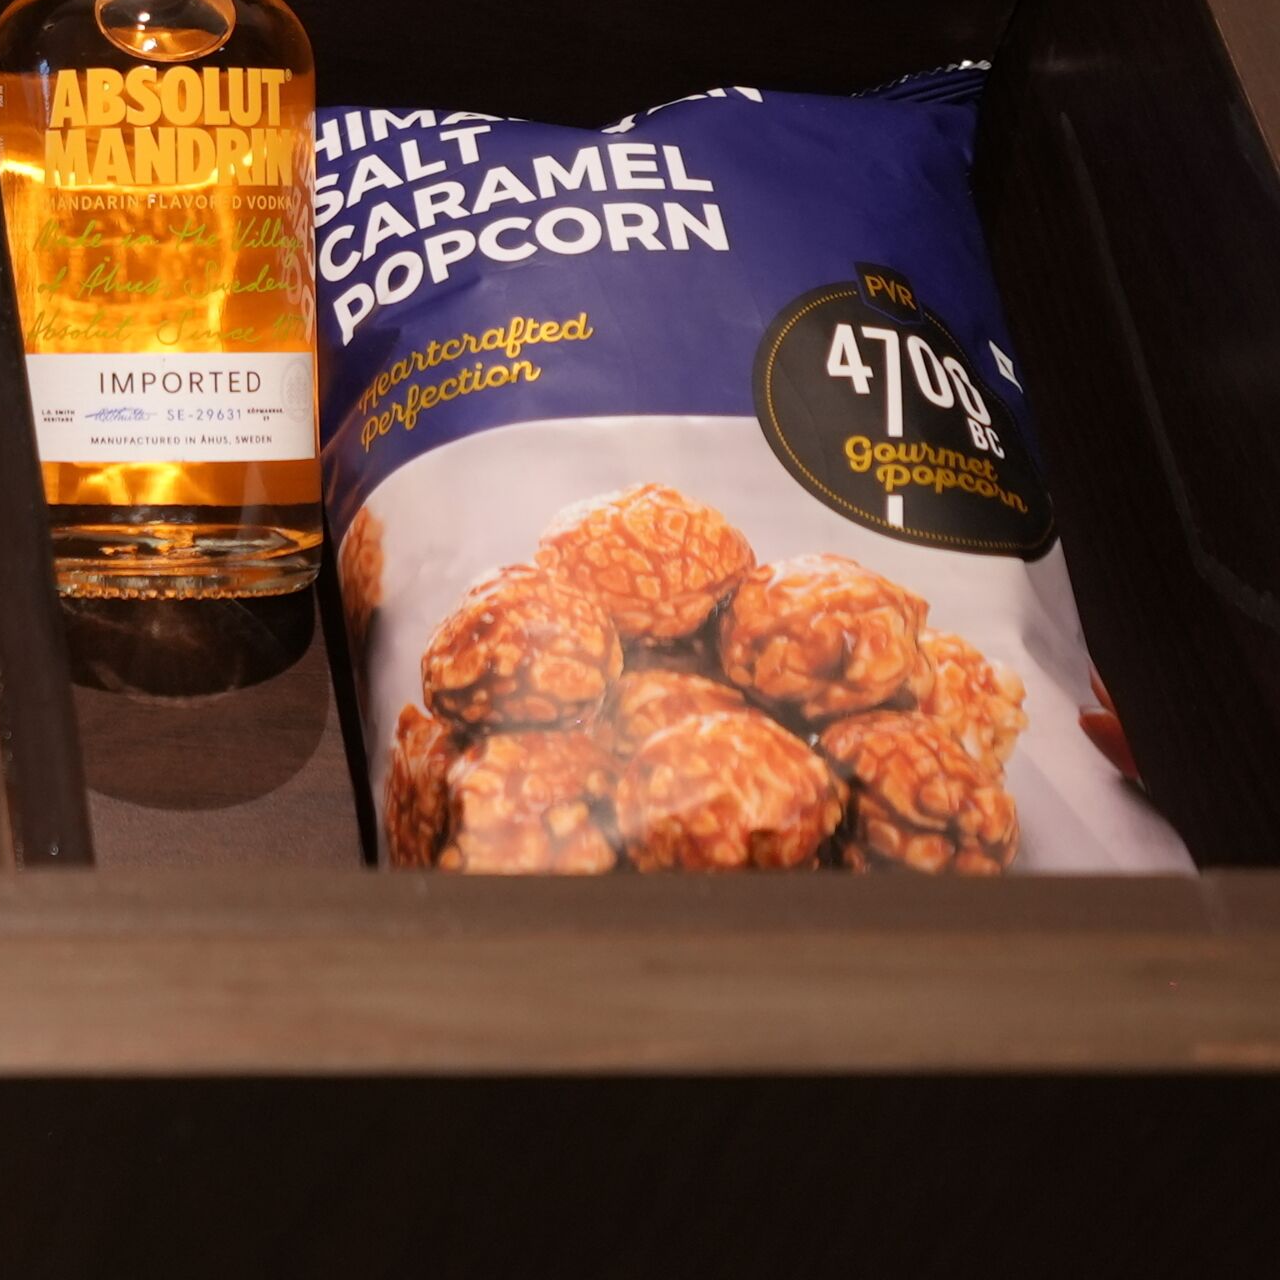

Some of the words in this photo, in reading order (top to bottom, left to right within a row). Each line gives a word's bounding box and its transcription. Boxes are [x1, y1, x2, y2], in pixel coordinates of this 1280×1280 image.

[48, 66, 288, 129] ABSOLUT
[44, 127, 292, 187] MANDRIN
[315, 125, 492, 228] SALT
[146, 194, 241, 210] FLAVORD
[319, 143, 715, 282] CARAMEL
[121, 228, 159, 248] in
[169, 220, 217, 249] the
[333, 203, 731, 346] POPCORN
[864, 275, 918, 311] PVR
[29, 308, 133, 341] Absolut
[156, 311, 263, 346] Since
[99, 370, 263, 395] IMPORTED
[358, 311, 594, 415] Heartcrafted
[826, 323, 992, 438] 4700
[167, 408, 241, 421] SE-29631
[90, 436, 181, 446] MANUFACTURED
[185, 436, 197, 445] IN
[235, 435, 273, 445] SWEDEN
[845, 435, 999, 483] Gourmet
[967, 418, 1006, 460] BC
